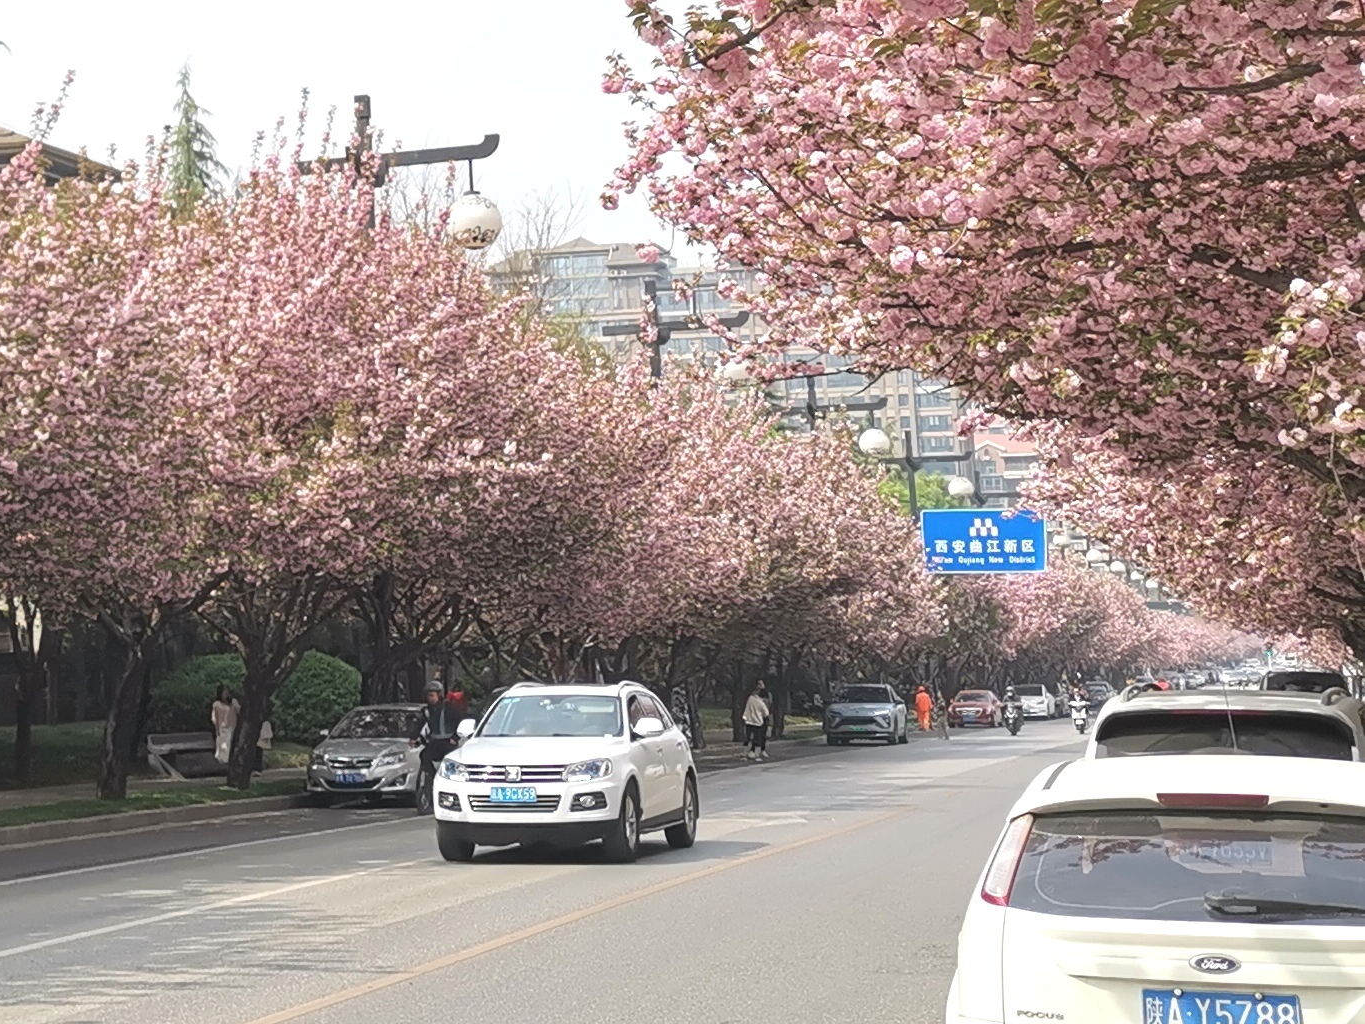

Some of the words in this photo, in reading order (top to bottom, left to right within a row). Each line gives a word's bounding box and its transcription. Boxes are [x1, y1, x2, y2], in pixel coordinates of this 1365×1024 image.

[934, 539, 1035, 553] 西安曲江新区
[1009, 556, 1036, 564] District
[1201, 952, 1229, 970] Ford
